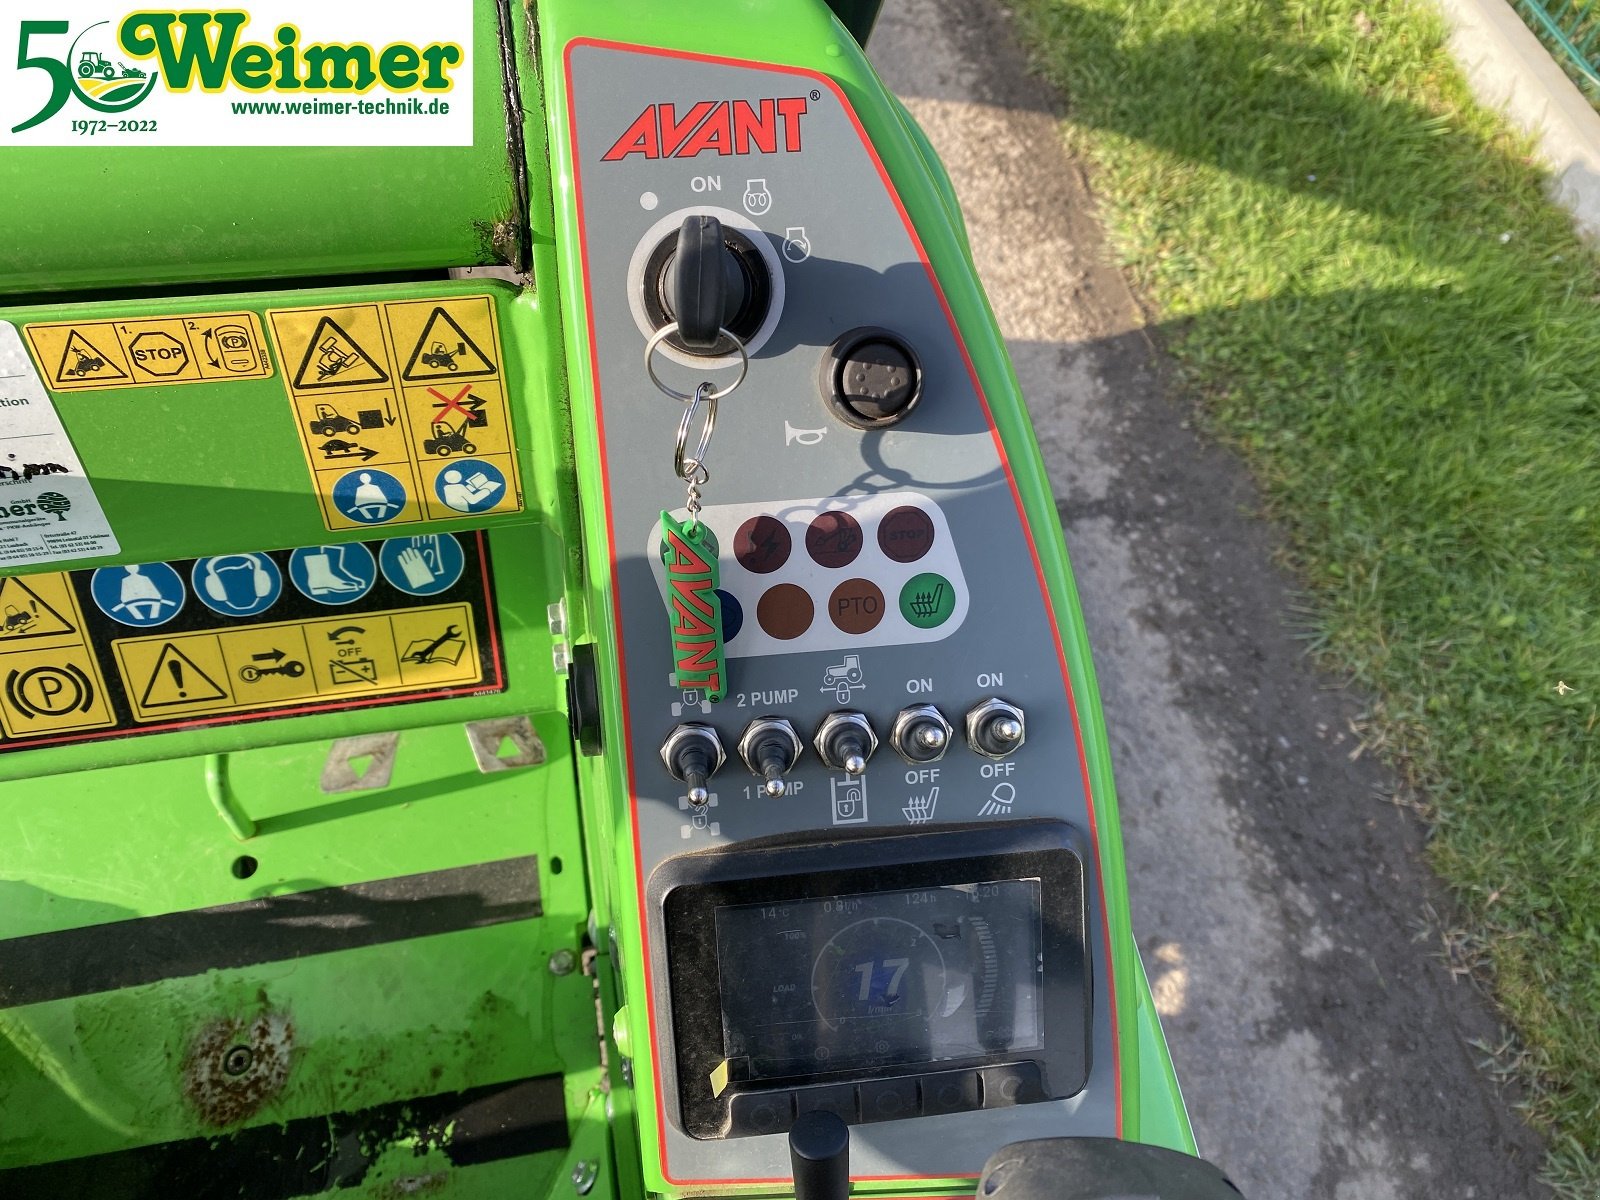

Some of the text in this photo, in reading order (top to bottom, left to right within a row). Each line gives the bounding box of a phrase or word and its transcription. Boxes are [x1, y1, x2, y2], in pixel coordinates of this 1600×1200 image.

[601, 97, 807, 162] AVANT
[691, 176, 721, 192] ON
[120, 325, 132, 335] 1.
[187, 321, 200, 331] 2.
[135, 347, 182, 361] STOP
[0, 398, 29, 406] tion
[889, 528, 925, 542] STOP
[667, 529, 721, 692] AVANT
[838, 596, 878, 616] PTO
[337, 647, 362, 658] OFF
[906, 678, 932, 694] ON
[976, 672, 1003, 688] ON
[38, 676, 63, 709] P
[736, 688, 799, 708] 2 PUMP
[904, 768, 941, 785] OFF
[979, 762, 1015, 779] OFF
[743, 781, 804, 800] 1 PMP
[855, 957, 910, 1001] 17
